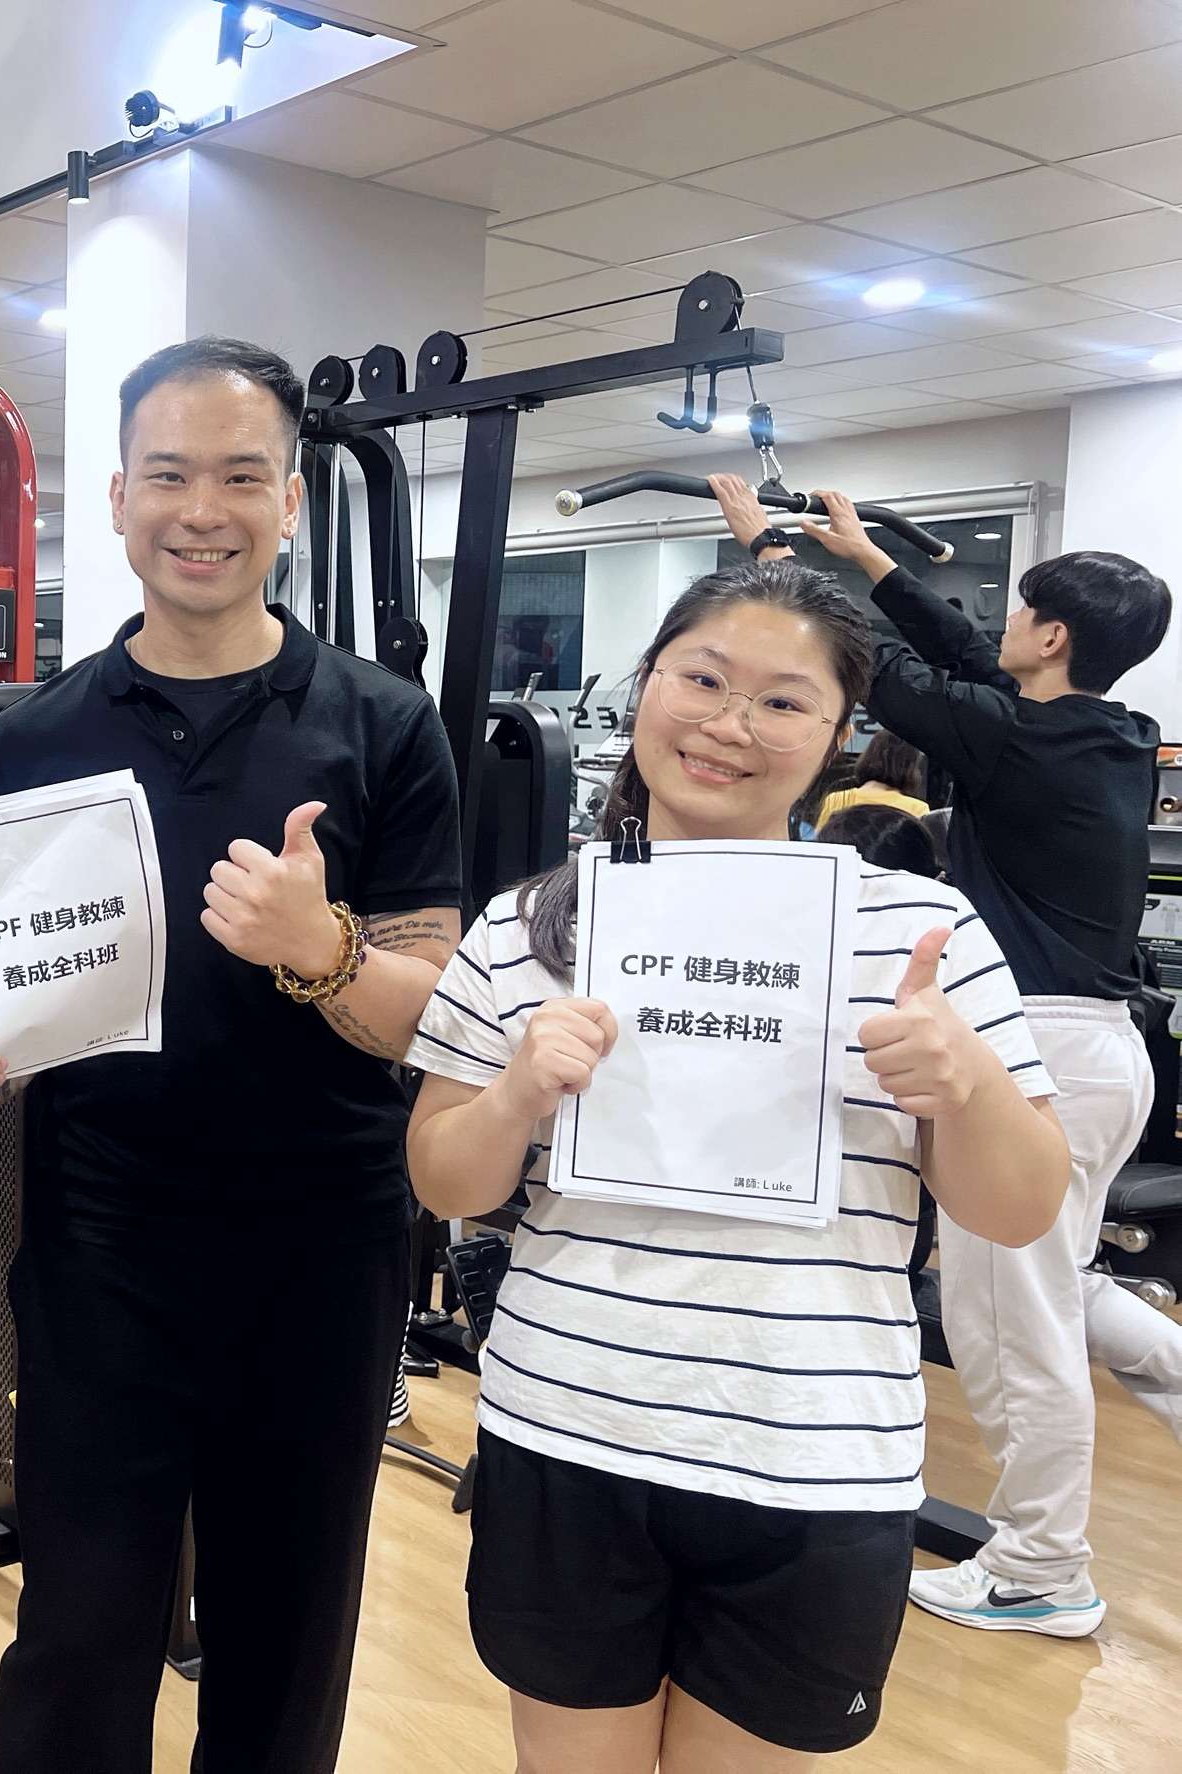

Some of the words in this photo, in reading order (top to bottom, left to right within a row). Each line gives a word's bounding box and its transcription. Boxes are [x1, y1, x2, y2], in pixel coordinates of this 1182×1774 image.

[29, 895, 126, 937] 健身教練
[2, 943, 120, 990] 養成全科班
[620, 954, 675, 977] CPF
[683, 955, 801, 990] 健身教練
[636, 1006, 783, 1044] 養成全科班
